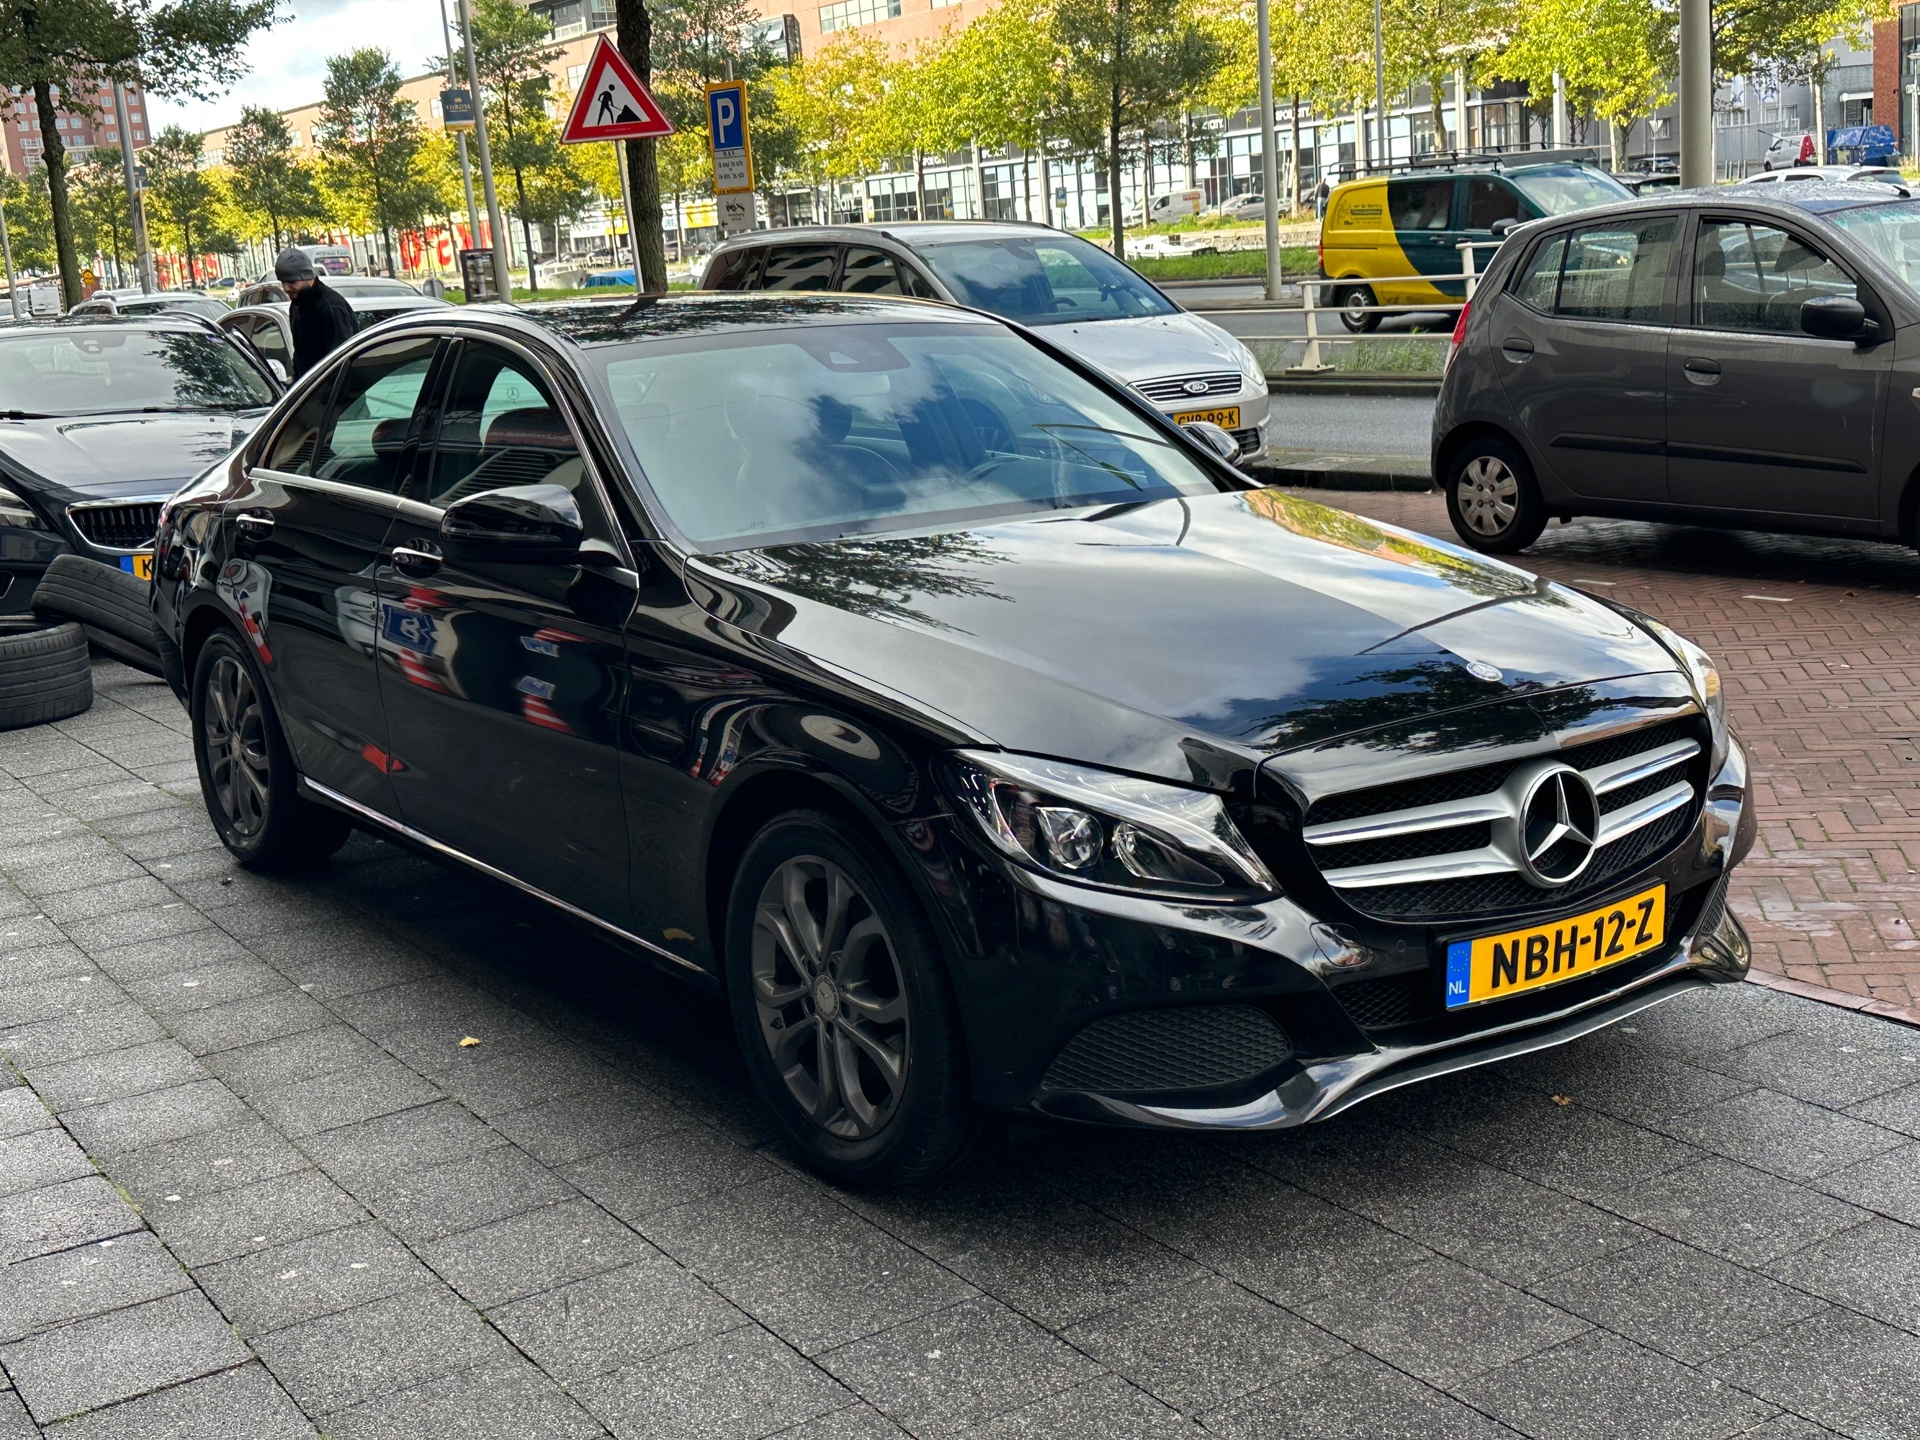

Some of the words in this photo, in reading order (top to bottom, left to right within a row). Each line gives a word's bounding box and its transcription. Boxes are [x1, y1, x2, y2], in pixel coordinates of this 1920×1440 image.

[716, 97, 735, 144] P
[1275, 106, 1311, 121] SPOCITY
[1491, 897, 1655, 989] NBH-12-Z
[1448, 980, 1467, 996] NL
